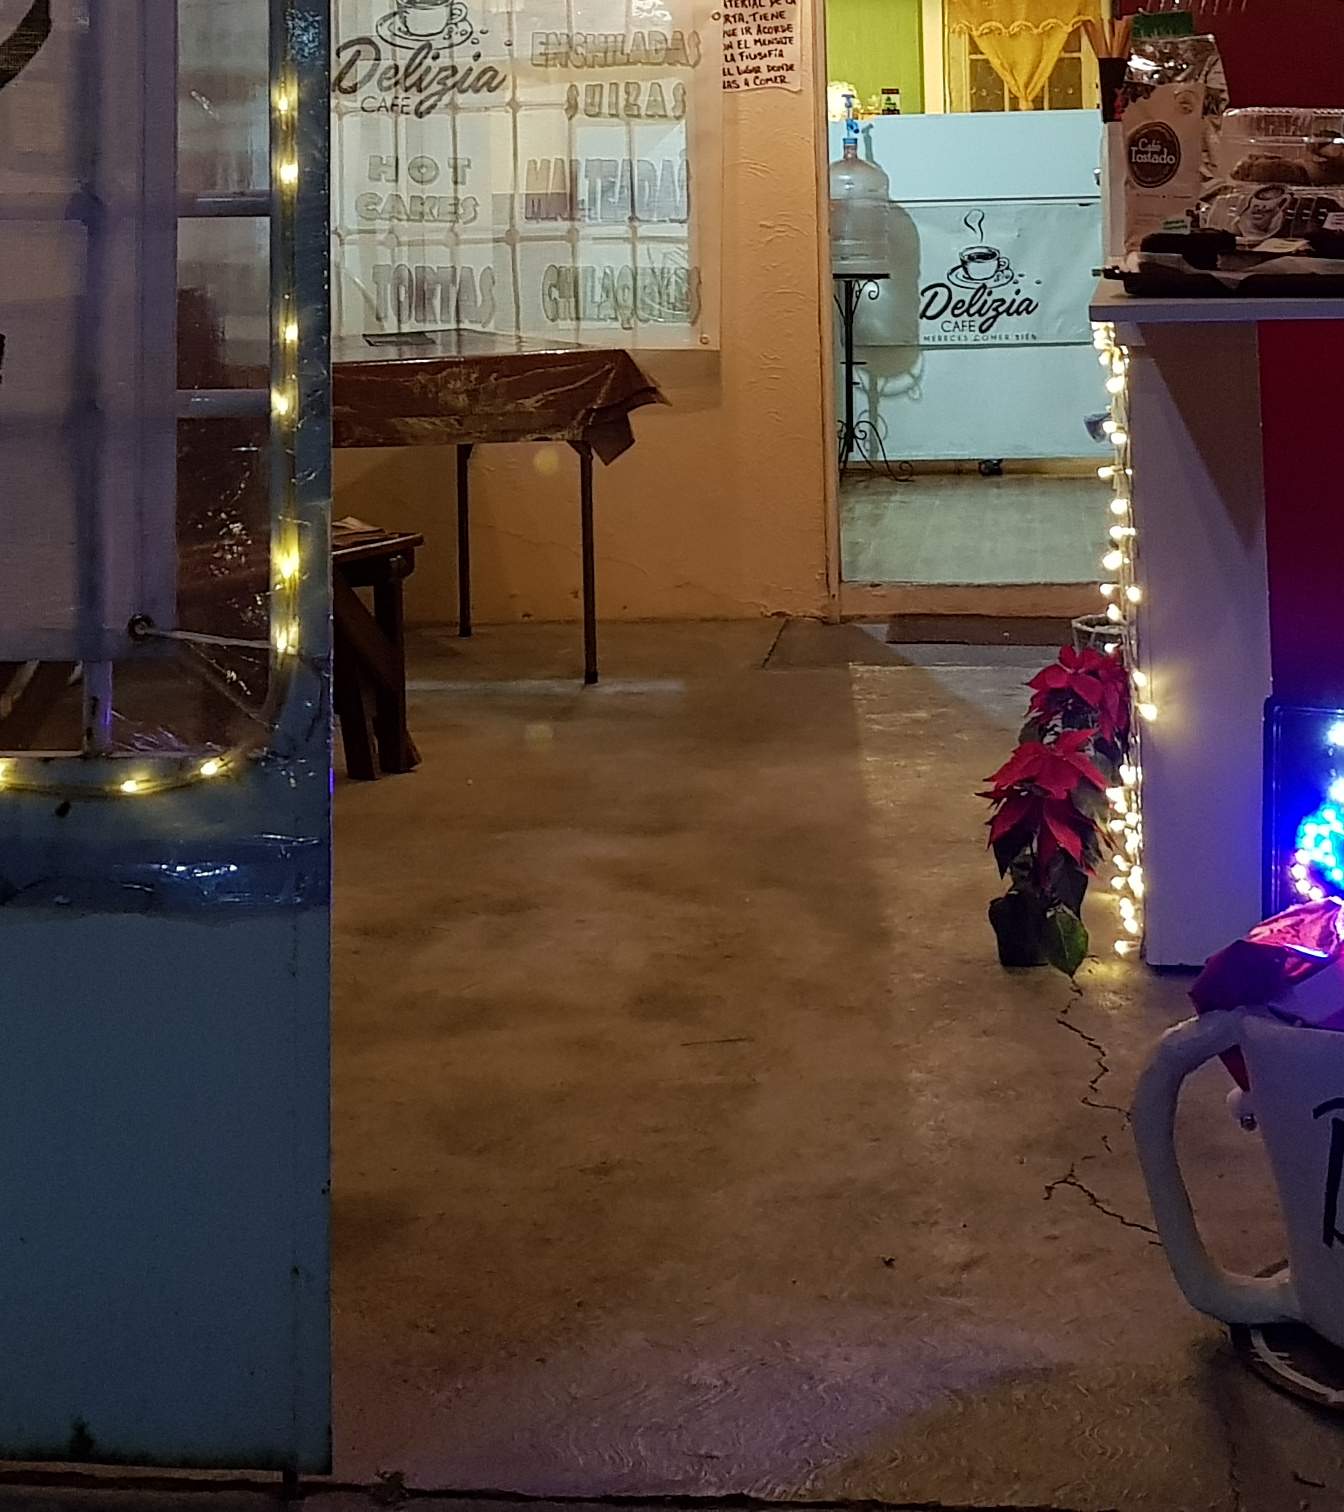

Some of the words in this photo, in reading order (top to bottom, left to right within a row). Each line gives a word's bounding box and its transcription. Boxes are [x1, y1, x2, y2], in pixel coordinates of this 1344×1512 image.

[749, 10, 787, 22] TIENE
[756, 24, 794, 35] ACORDE
[737, 39, 751, 50] EL
[332, 37, 508, 119] Delizia
[753, 75, 791, 87] COMER
[360, 95, 412, 116] CAFE
[565, 81, 687, 121] SUIZAS
[1131, 147, 1176, 164] Tostado
[367, 155, 472, 186] HOT
[355, 192, 480, 226] CAKES
[372, 263, 496, 329] TORTAS
[919, 282, 1040, 334] Delizia
[941, 320, 976, 333] CAFE
